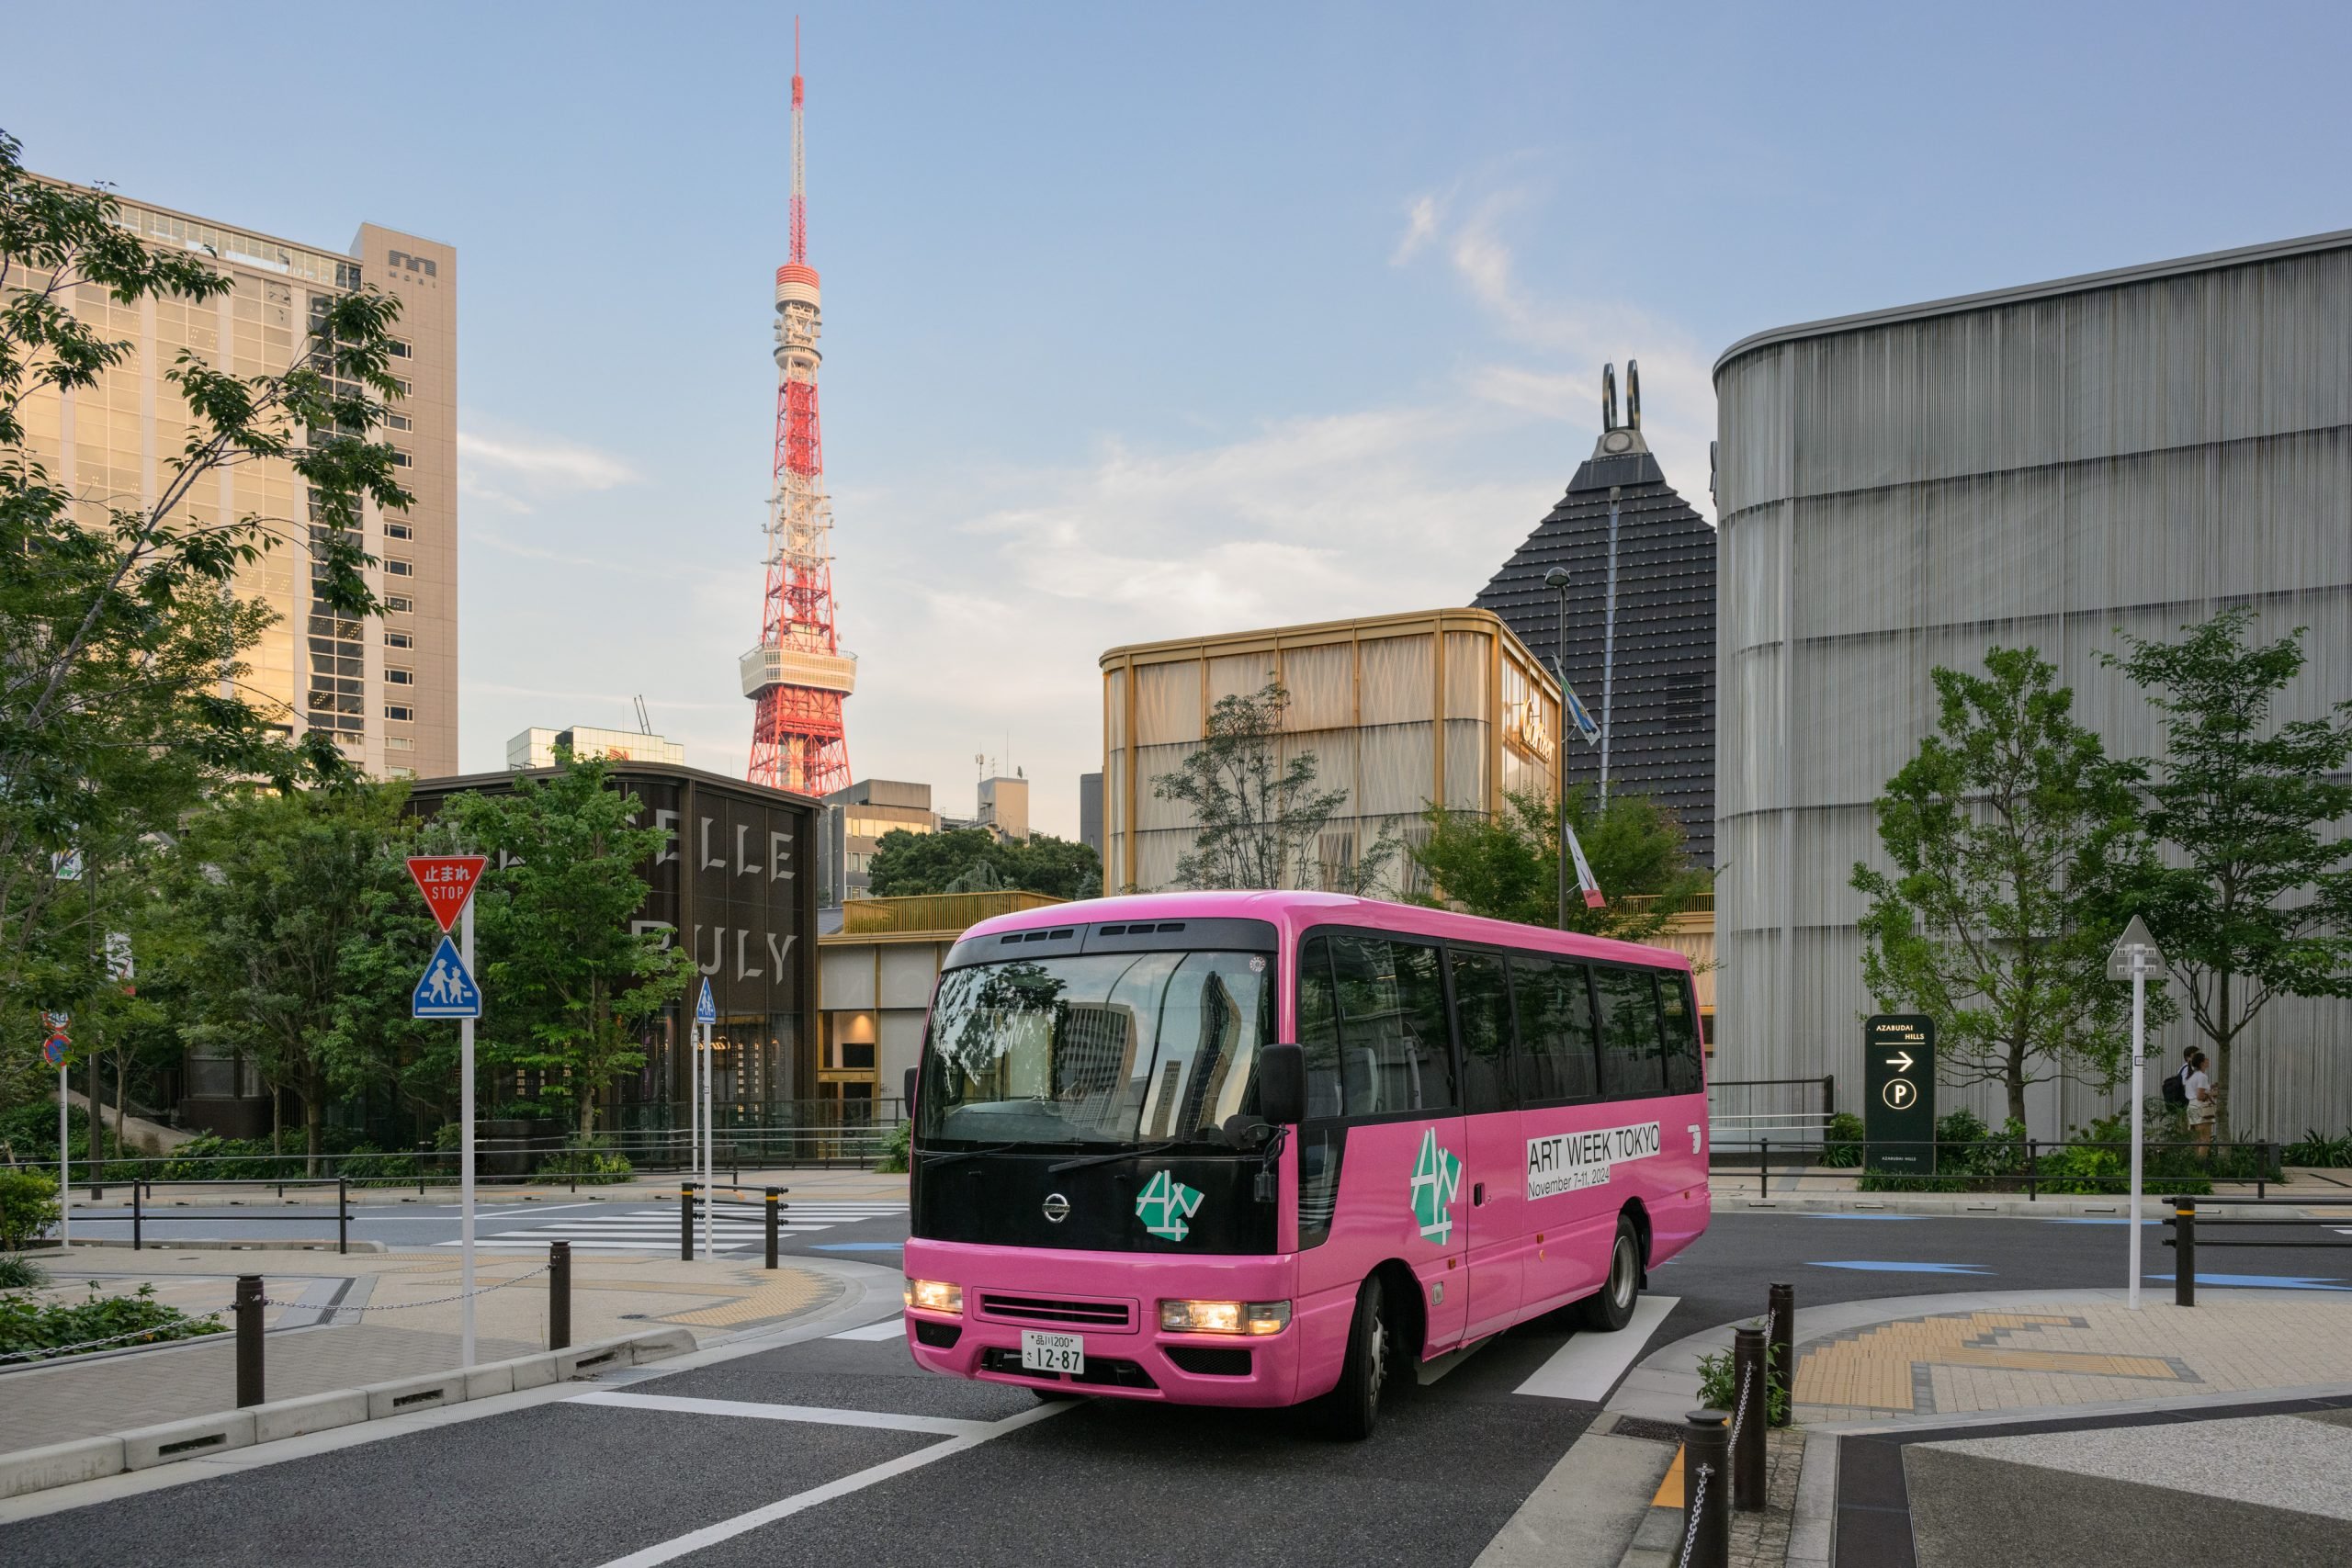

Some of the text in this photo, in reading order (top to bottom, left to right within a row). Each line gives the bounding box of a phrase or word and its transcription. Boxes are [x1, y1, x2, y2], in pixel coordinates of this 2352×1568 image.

[389, 270, 436, 288] MORI
[1521, 698, 1555, 761] Cartier
[626, 809, 796, 883] ELLE
[424, 865, 471, 882] 止まれ
[432, 886, 464, 900] STOP
[1894, 1084, 1907, 1104] P
[1528, 1123, 1660, 1175] ART WEEK TOKYO
[1528, 1176, 1572, 1199] November
[1591, 1168, 1610, 1184] 2024
[1026, 1348, 1080, 1371] さ 12-87
